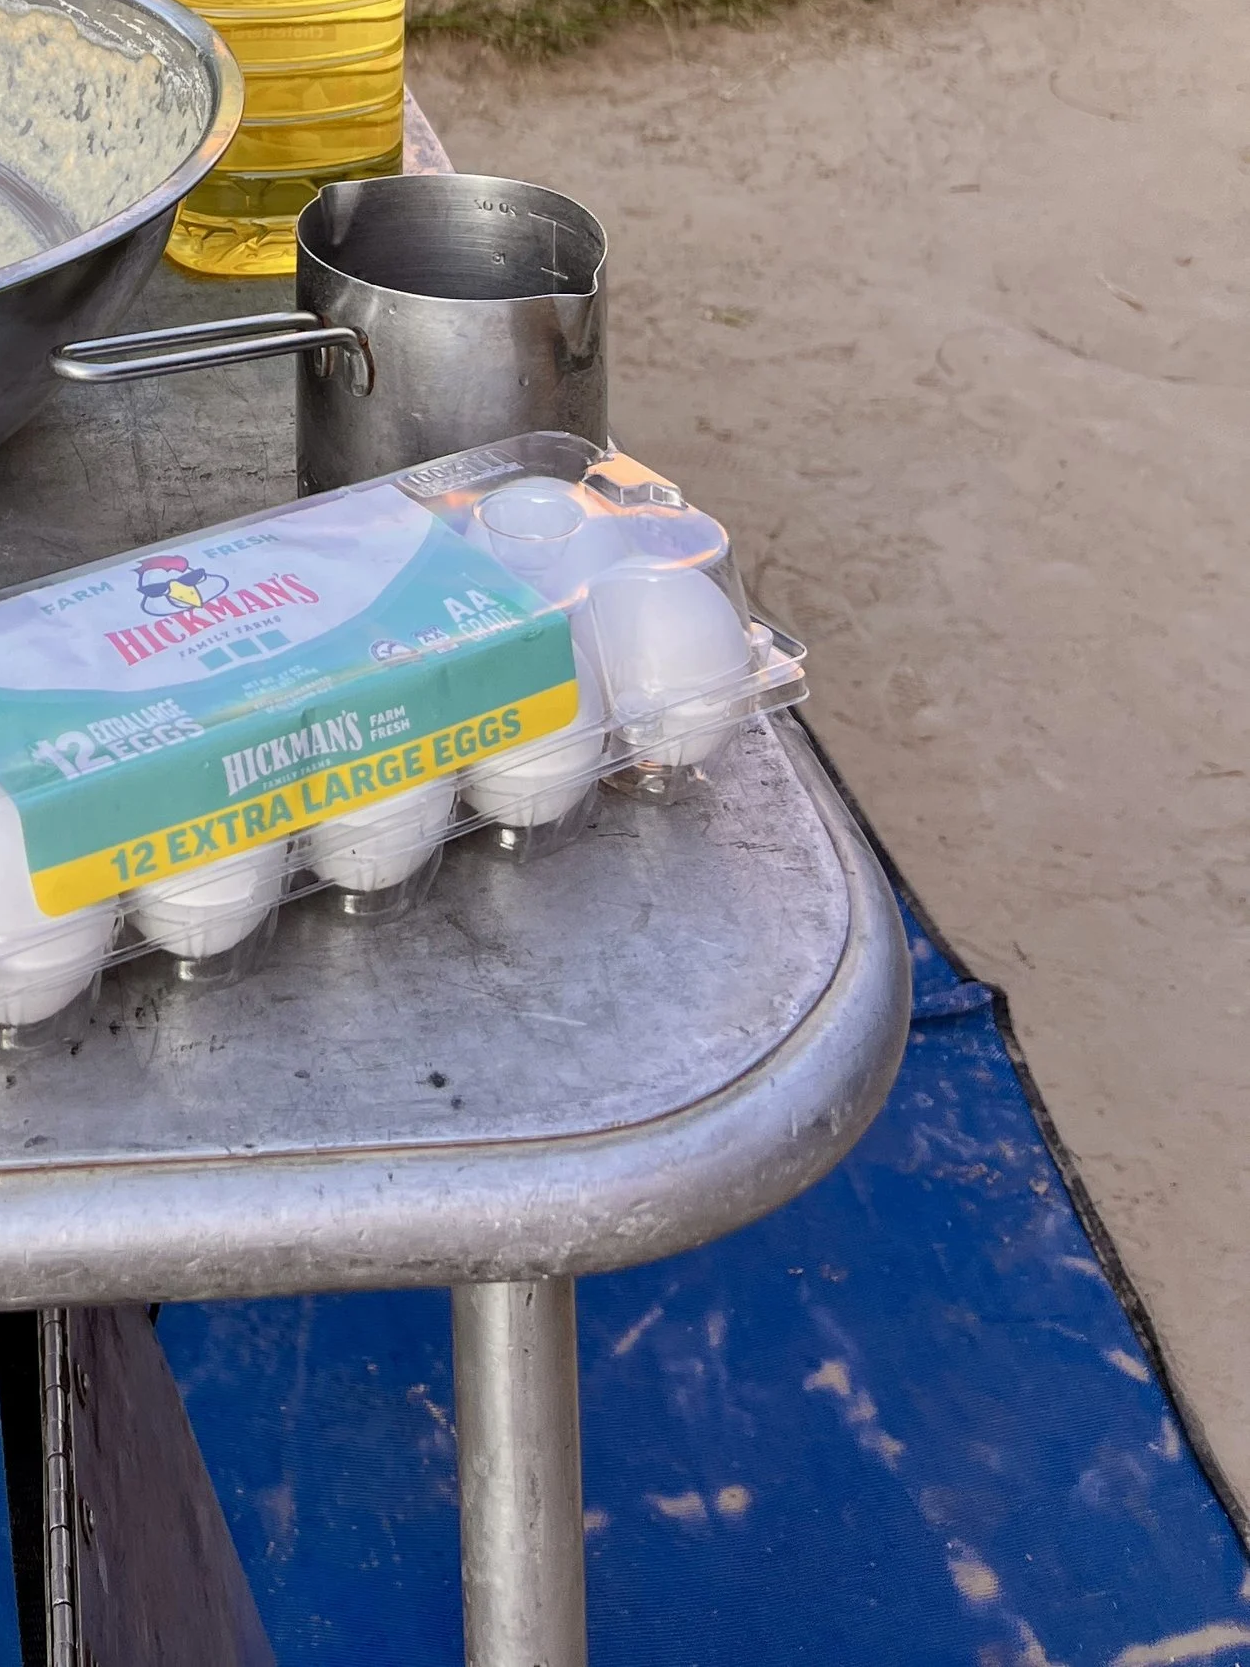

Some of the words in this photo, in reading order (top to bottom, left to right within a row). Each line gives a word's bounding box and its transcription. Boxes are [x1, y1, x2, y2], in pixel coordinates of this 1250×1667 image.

[202, 533, 280, 560] FRESH
[40, 581, 114, 616] FARM
[104, 572, 320, 667] HICKMAN'S
[443, 589, 500, 623] AA
[179, 630, 231, 659] FAMILY
[235, 614, 282, 636] FARMS
[458, 604, 520, 642] GRADE
[86, 712, 137, 745] EXTRA
[130, 698, 187, 727] LARGE
[369, 705, 405, 727] FARM
[370, 718, 411, 742] FRESH
[31, 730, 116, 780] 12
[102, 716, 205, 762] EGGS
[221, 709, 363, 797] HICKMAN'S
[111, 840, 158, 882] 12
[168, 794, 293, 866] EXTRA
[302, 744, 426, 816] LARGE
[434, 708, 521, 768] EGGS
